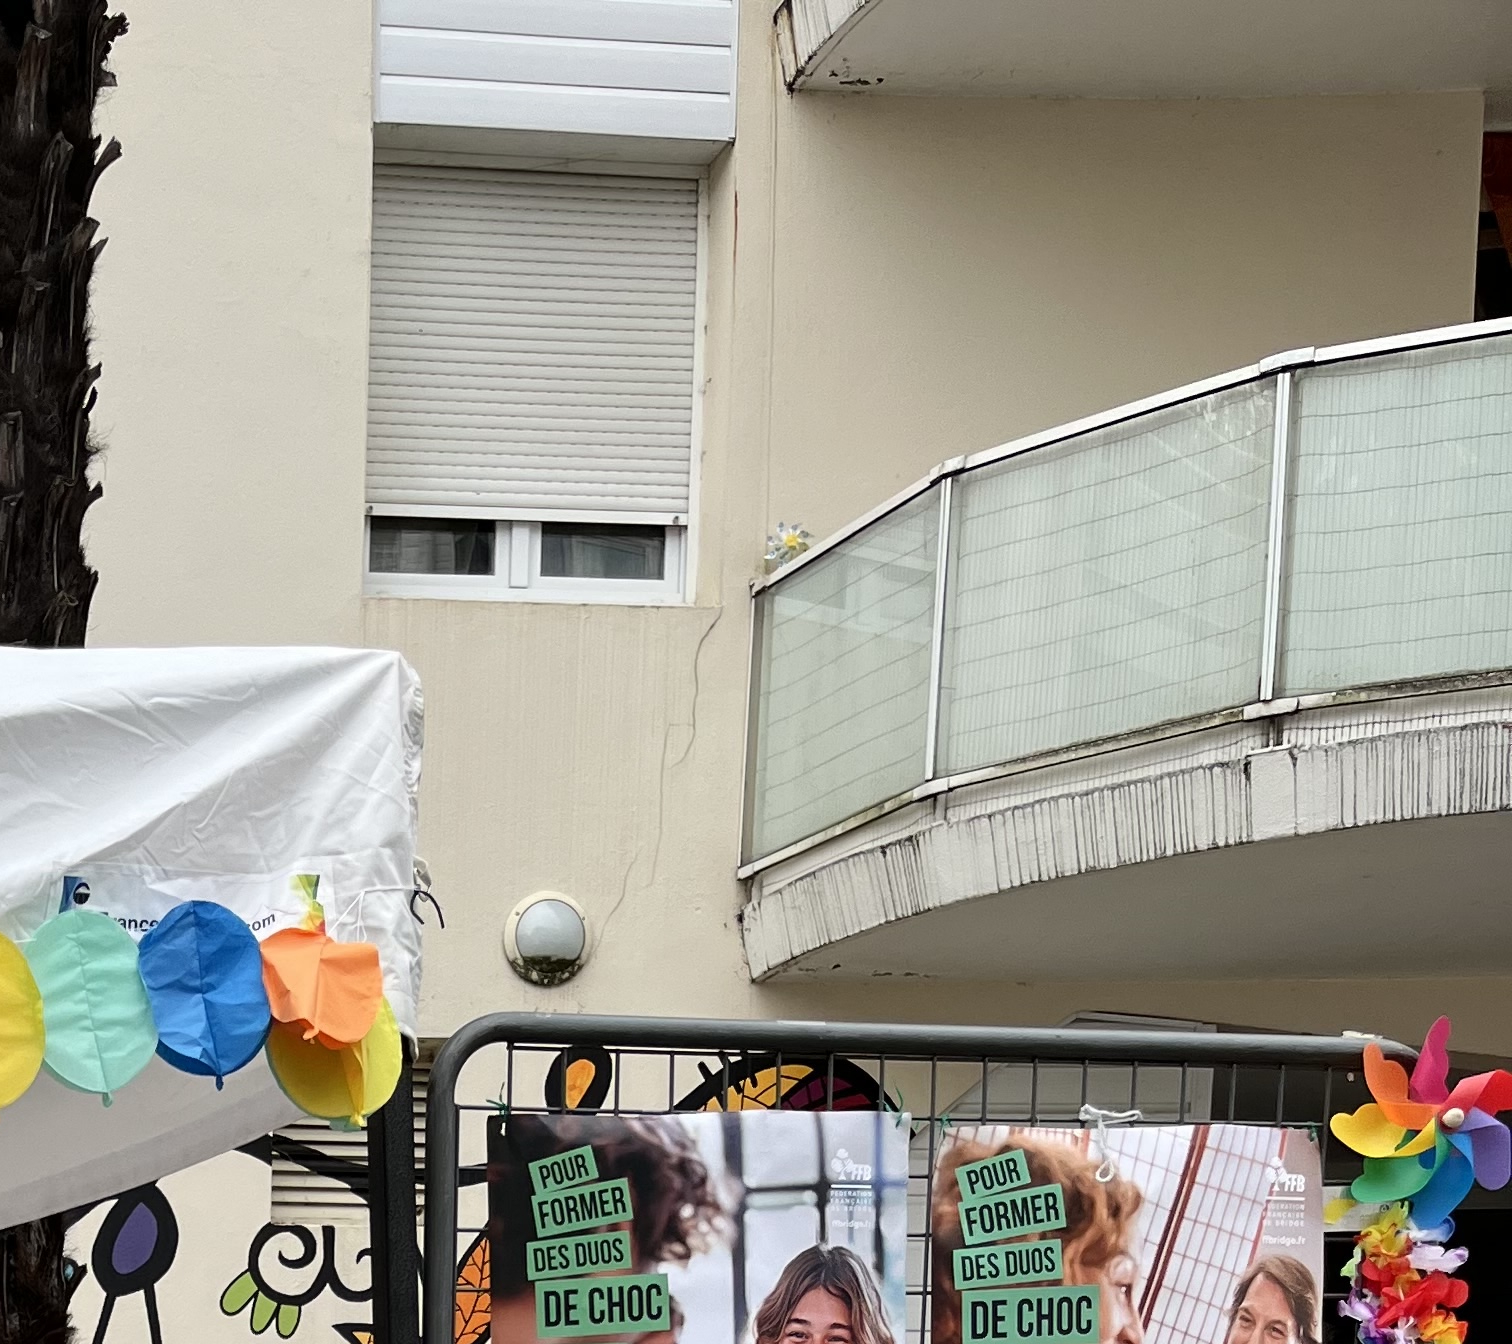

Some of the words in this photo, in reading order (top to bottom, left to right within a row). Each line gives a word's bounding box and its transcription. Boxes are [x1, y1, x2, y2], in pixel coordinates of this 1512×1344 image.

[538, 1154, 588, 1189] POUR
[966, 1159, 1021, 1194] POUR
[1285, 1174, 1306, 1192] FFB
[538, 1188, 627, 1228] FORMER
[965, 1191, 1060, 1236] FORMER
[533, 1245, 570, 1273] DES
[575, 1239, 624, 1267] DUOS
[961, 1252, 999, 1282] DES
[1005, 1246, 1056, 1276] DUOS
[543, 1288, 578, 1328] DE
[588, 1284, 663, 1323] CHOC
[970, 1300, 1006, 1339] DE
[1016, 1295, 1092, 1337] CHOC
